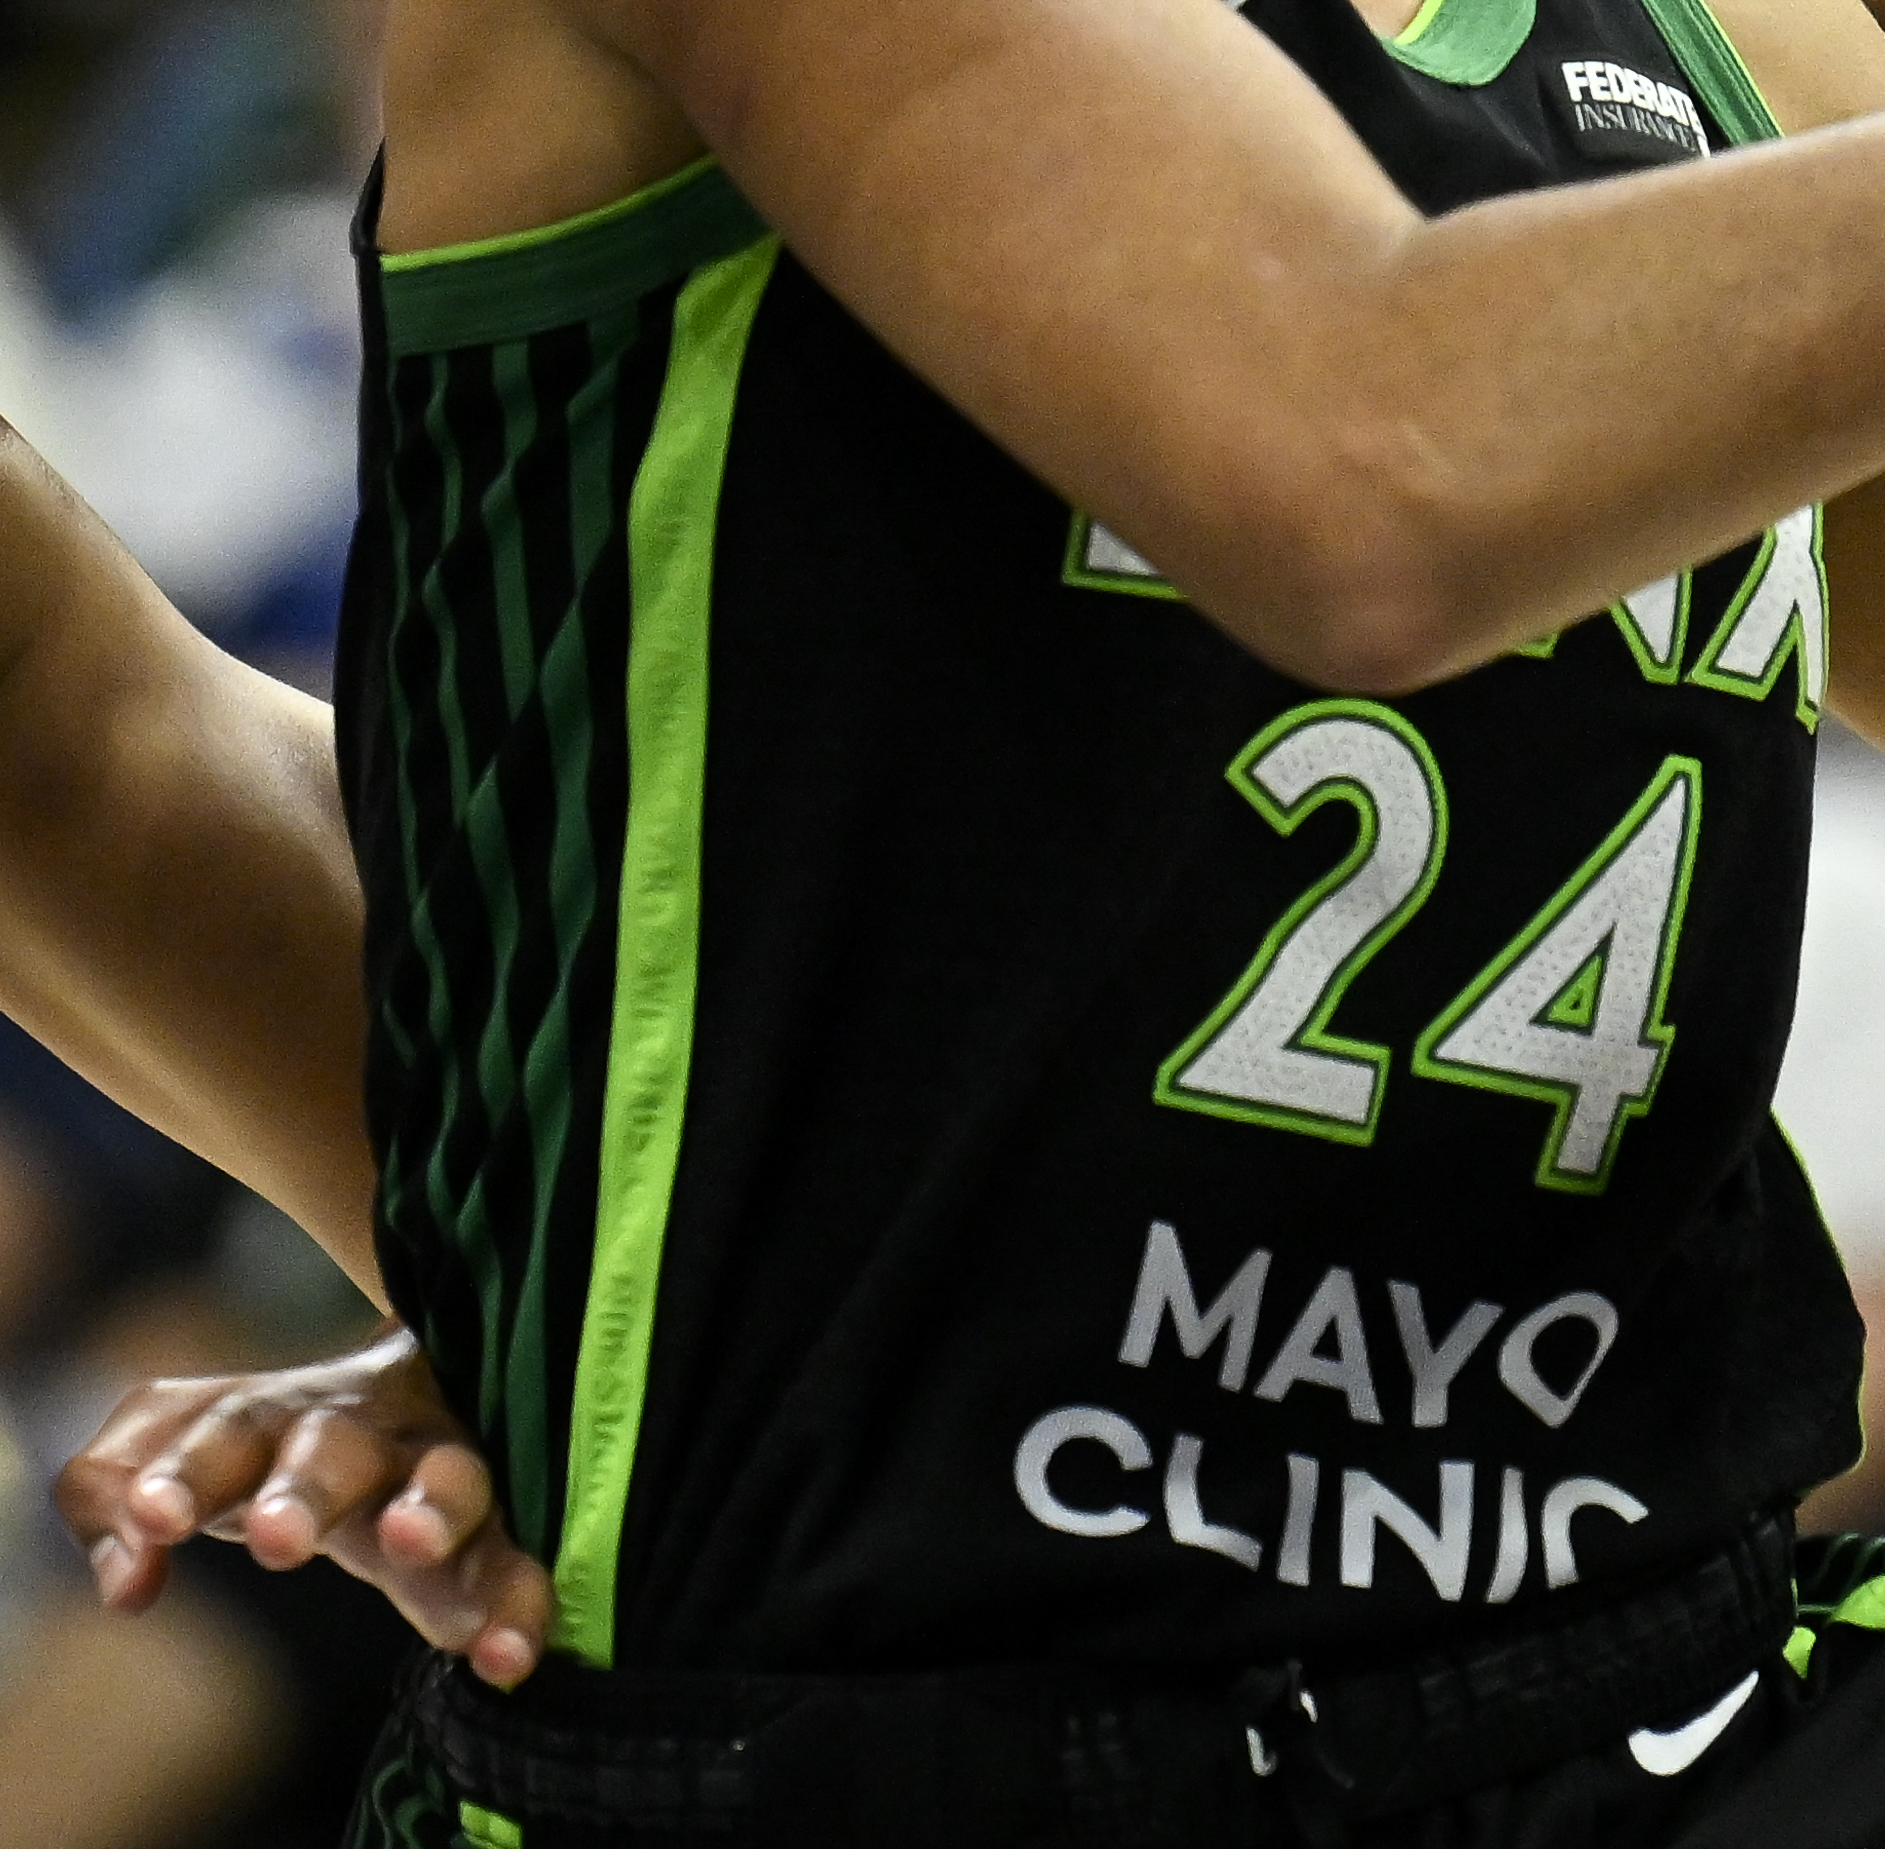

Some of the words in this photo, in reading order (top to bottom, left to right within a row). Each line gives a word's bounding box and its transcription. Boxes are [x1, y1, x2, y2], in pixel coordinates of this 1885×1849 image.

[1152, 697, 1702, 1194] 24
[1117, 1219, 1619, 1428] MAYO
[1013, 1404, 1651, 1605] CLINIC
